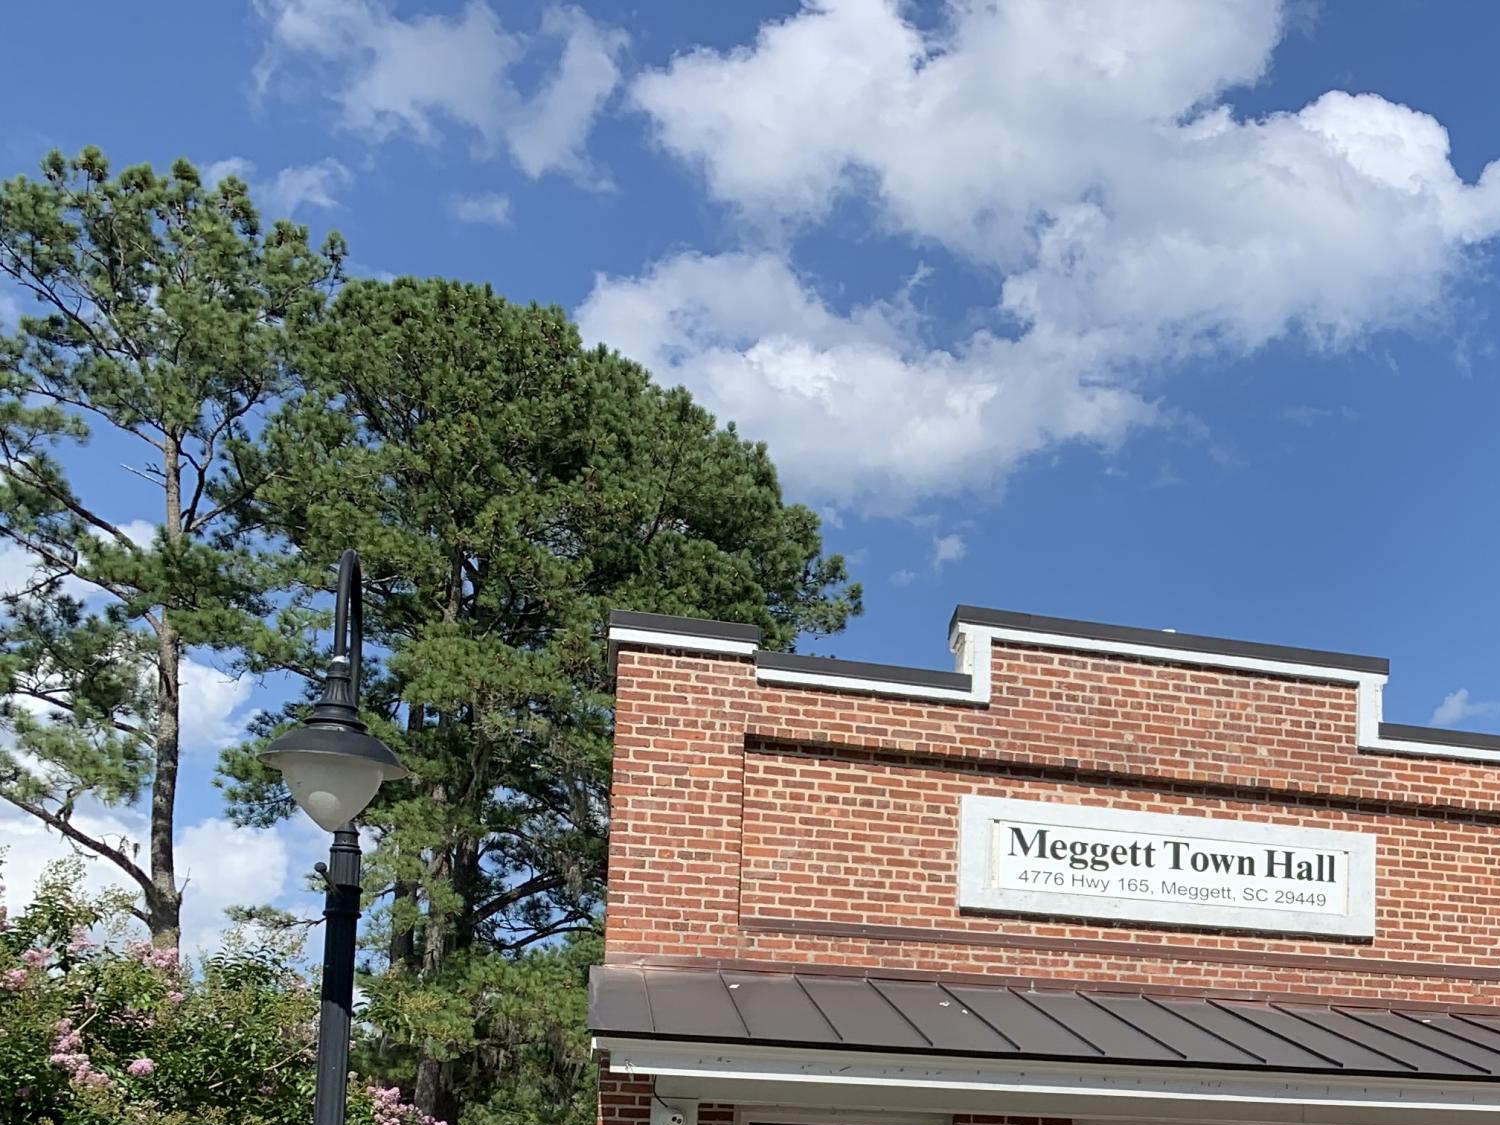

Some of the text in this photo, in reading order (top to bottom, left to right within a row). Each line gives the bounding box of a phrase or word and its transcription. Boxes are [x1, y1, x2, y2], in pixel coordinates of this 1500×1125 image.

[1007, 827, 1336, 883] Meggett Town Hall
[1018, 870, 1327, 907] 4776 Hwy 165, Meggett, SC 29449
